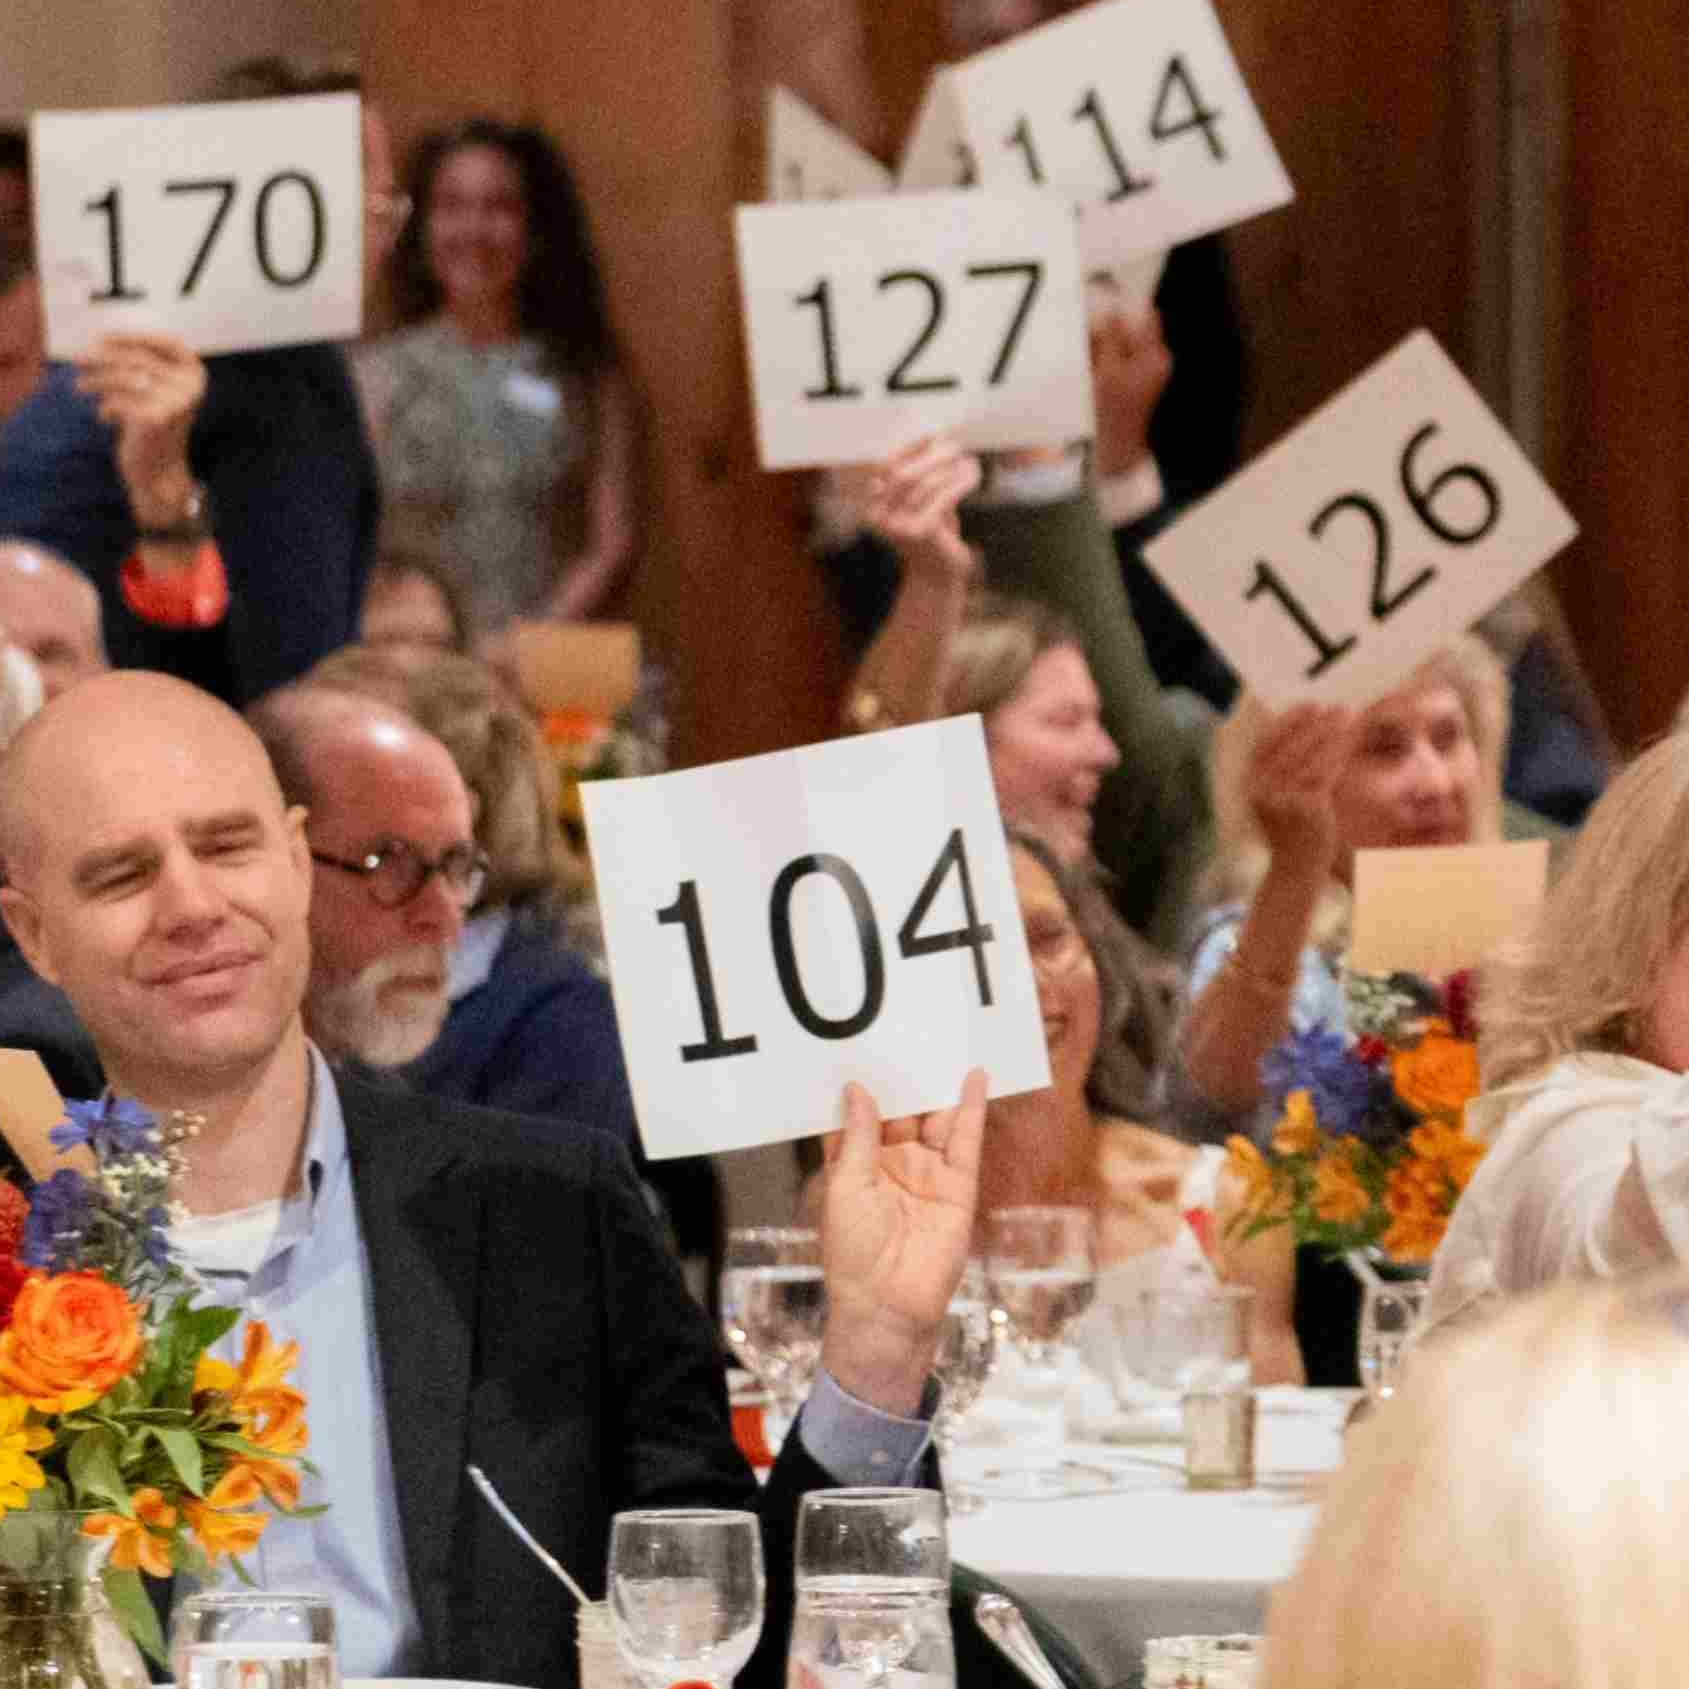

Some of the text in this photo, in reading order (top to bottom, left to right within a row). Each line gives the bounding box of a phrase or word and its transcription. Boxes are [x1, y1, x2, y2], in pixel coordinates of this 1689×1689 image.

[84, 169, 329, 306] 170
[794, 258, 1046, 403] 127
[1243, 419, 1503, 682] 126
[656, 827, 995, 1064] 104
